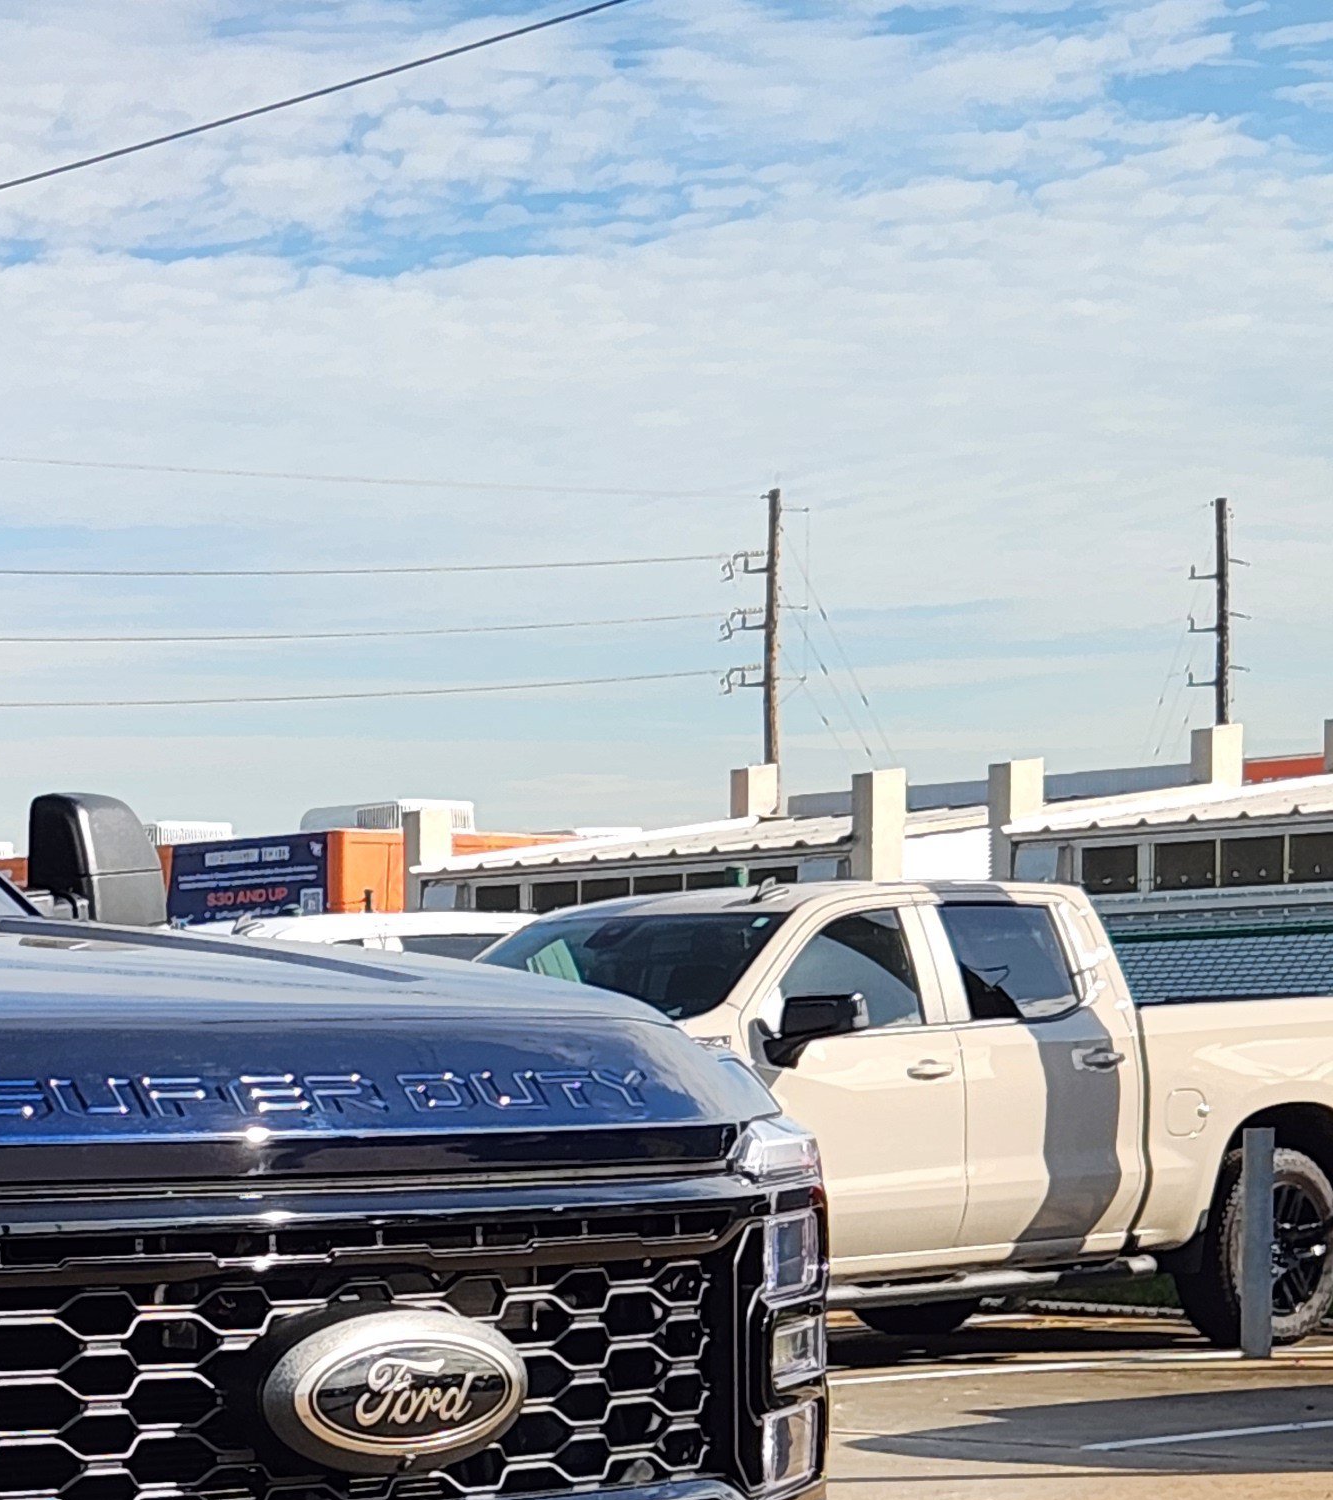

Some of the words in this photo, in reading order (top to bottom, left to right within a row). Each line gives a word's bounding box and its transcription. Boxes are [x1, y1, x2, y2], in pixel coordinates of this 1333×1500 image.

[236, 888, 267, 904] AND
[269, 886, 288, 902] UP
[395, 1069, 647, 1113] DUTY
[356, 1357, 475, 1427] Ford
